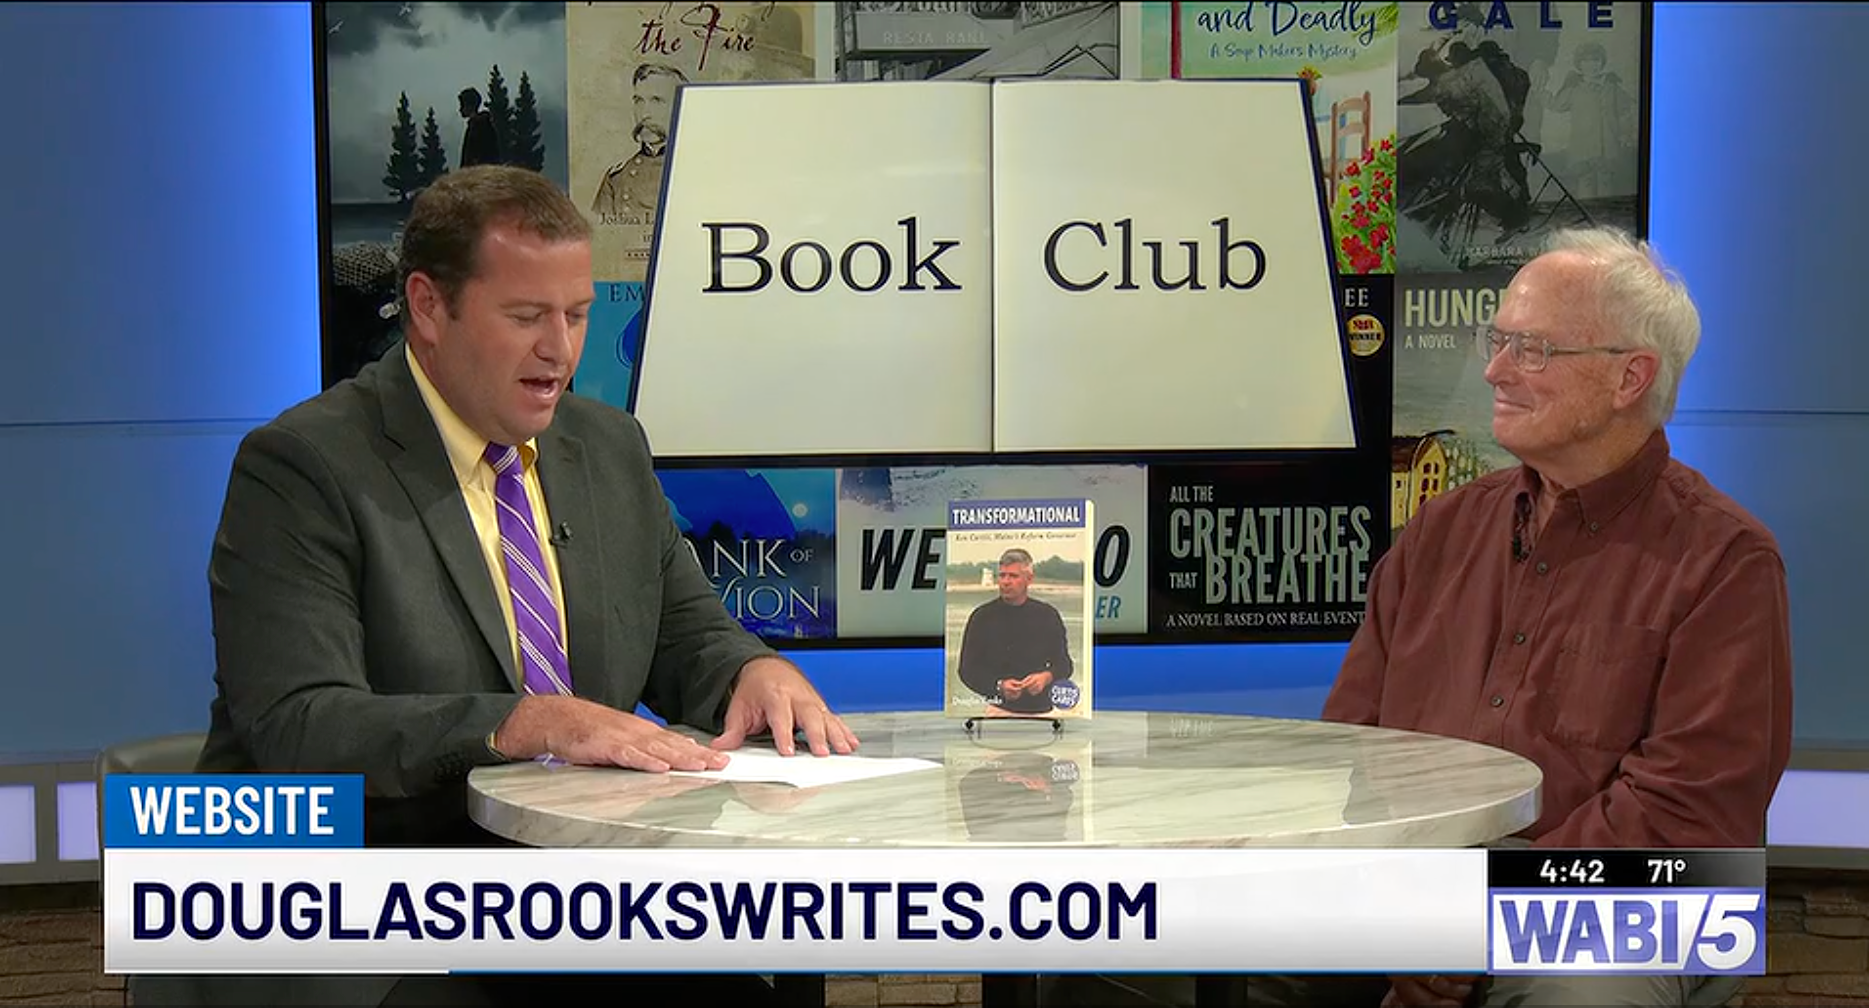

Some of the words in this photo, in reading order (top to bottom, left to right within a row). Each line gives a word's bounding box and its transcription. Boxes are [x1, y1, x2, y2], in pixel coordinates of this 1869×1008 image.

[1198, 2, 1255, 32] and
[1265, 2, 1376, 46] Deadly
[1428, 2, 1614, 30] GALE
[633, 18, 683, 55] the
[680, 4, 755, 71] Fire
[702, 217, 962, 293] Book
[1044, 218, 1267, 292] Club
[1405, 336, 1413, 349] A
[1419, 335, 1456, 349] NOVEL
[1169, 486, 1190, 502] ALL
[1193, 486, 1213, 502] THE
[952, 506, 1081, 525] TRANSFORMATIONAL
[1170, 506, 1371, 559] CREATURES
[789, 549, 814, 562] OF
[1169, 572, 1198, 589] THAT
[1206, 553, 1370, 604] BREATHE
[1166, 615, 1176, 627] A
[1178, 612, 1222, 626] NOVEL
[1224, 612, 1264, 626] BASED
[1266, 612, 1288, 626] ON
[1290, 611, 1321, 625] REAL
